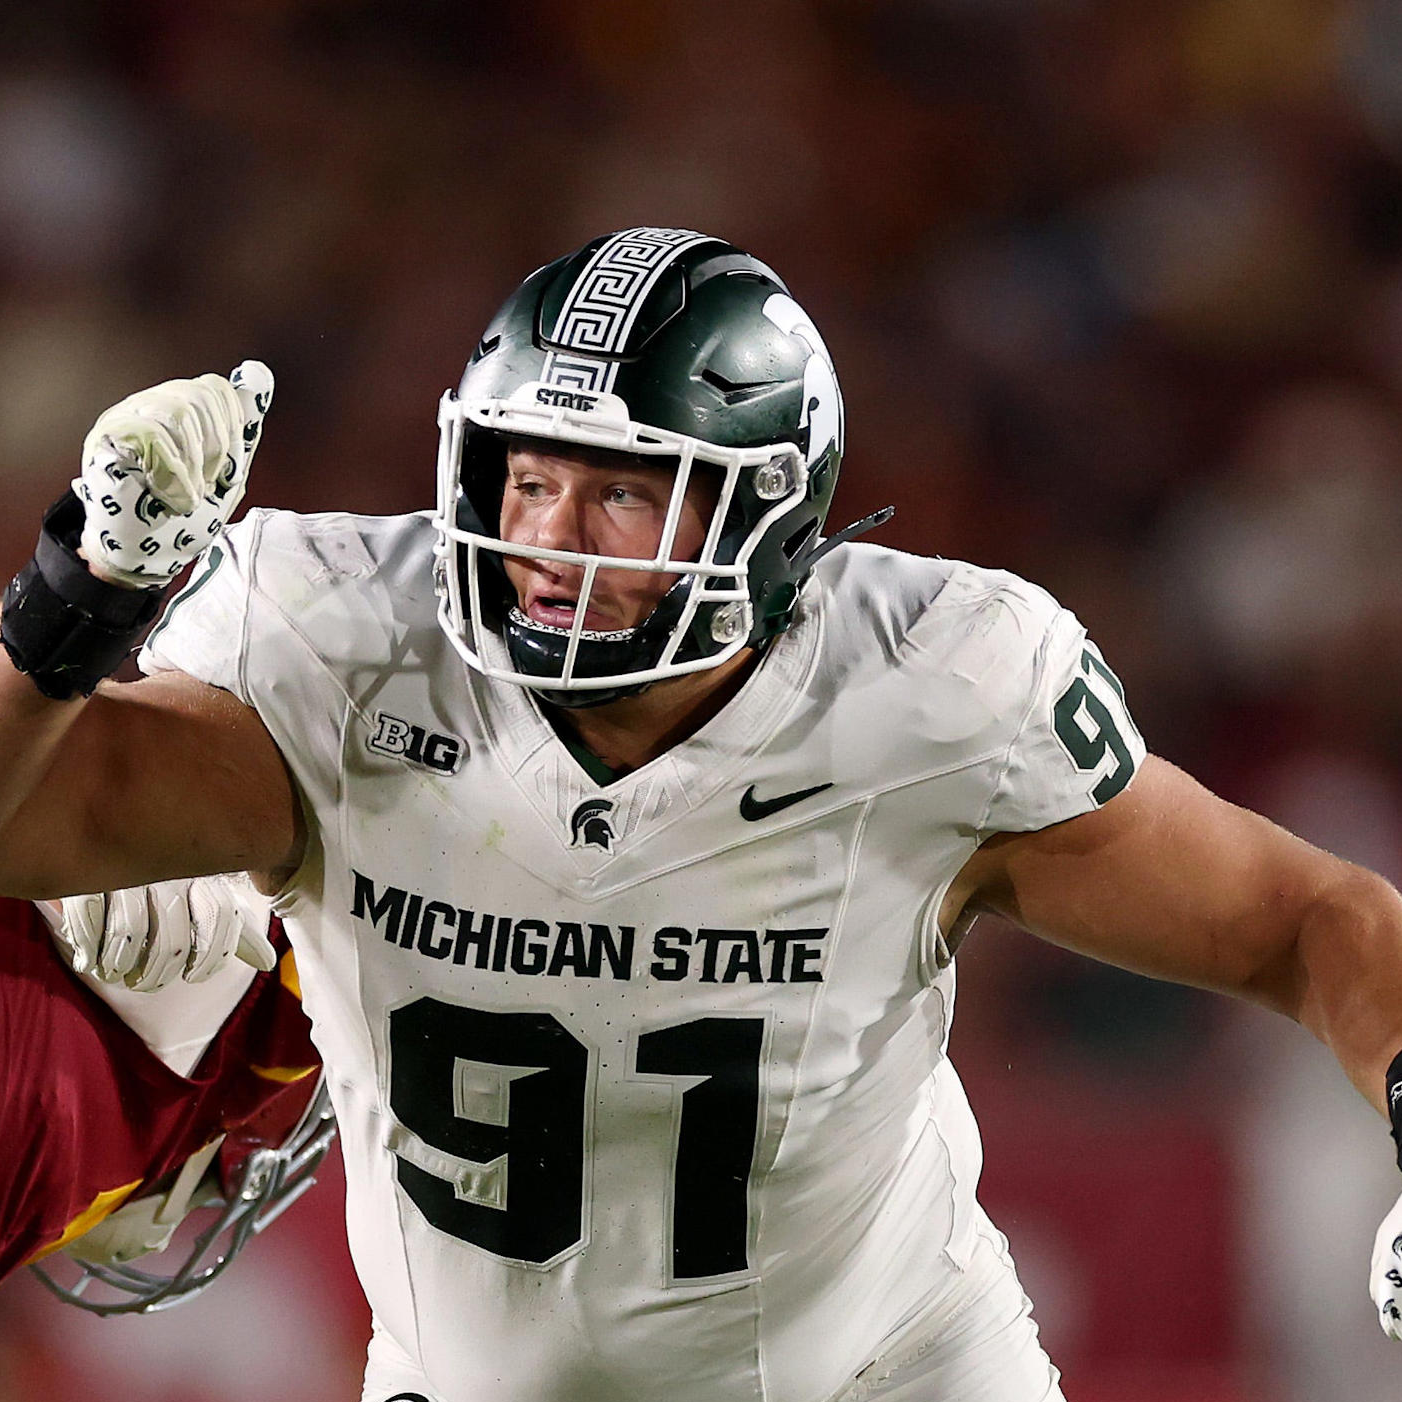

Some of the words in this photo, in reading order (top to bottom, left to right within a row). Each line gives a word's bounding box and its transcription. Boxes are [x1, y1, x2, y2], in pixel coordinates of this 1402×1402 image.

[536, 387, 599, 412] STATE
[350, 868, 636, 982] MICHIGAN
[650, 926, 830, 984] STATE
[388, 995, 766, 1281] 91
